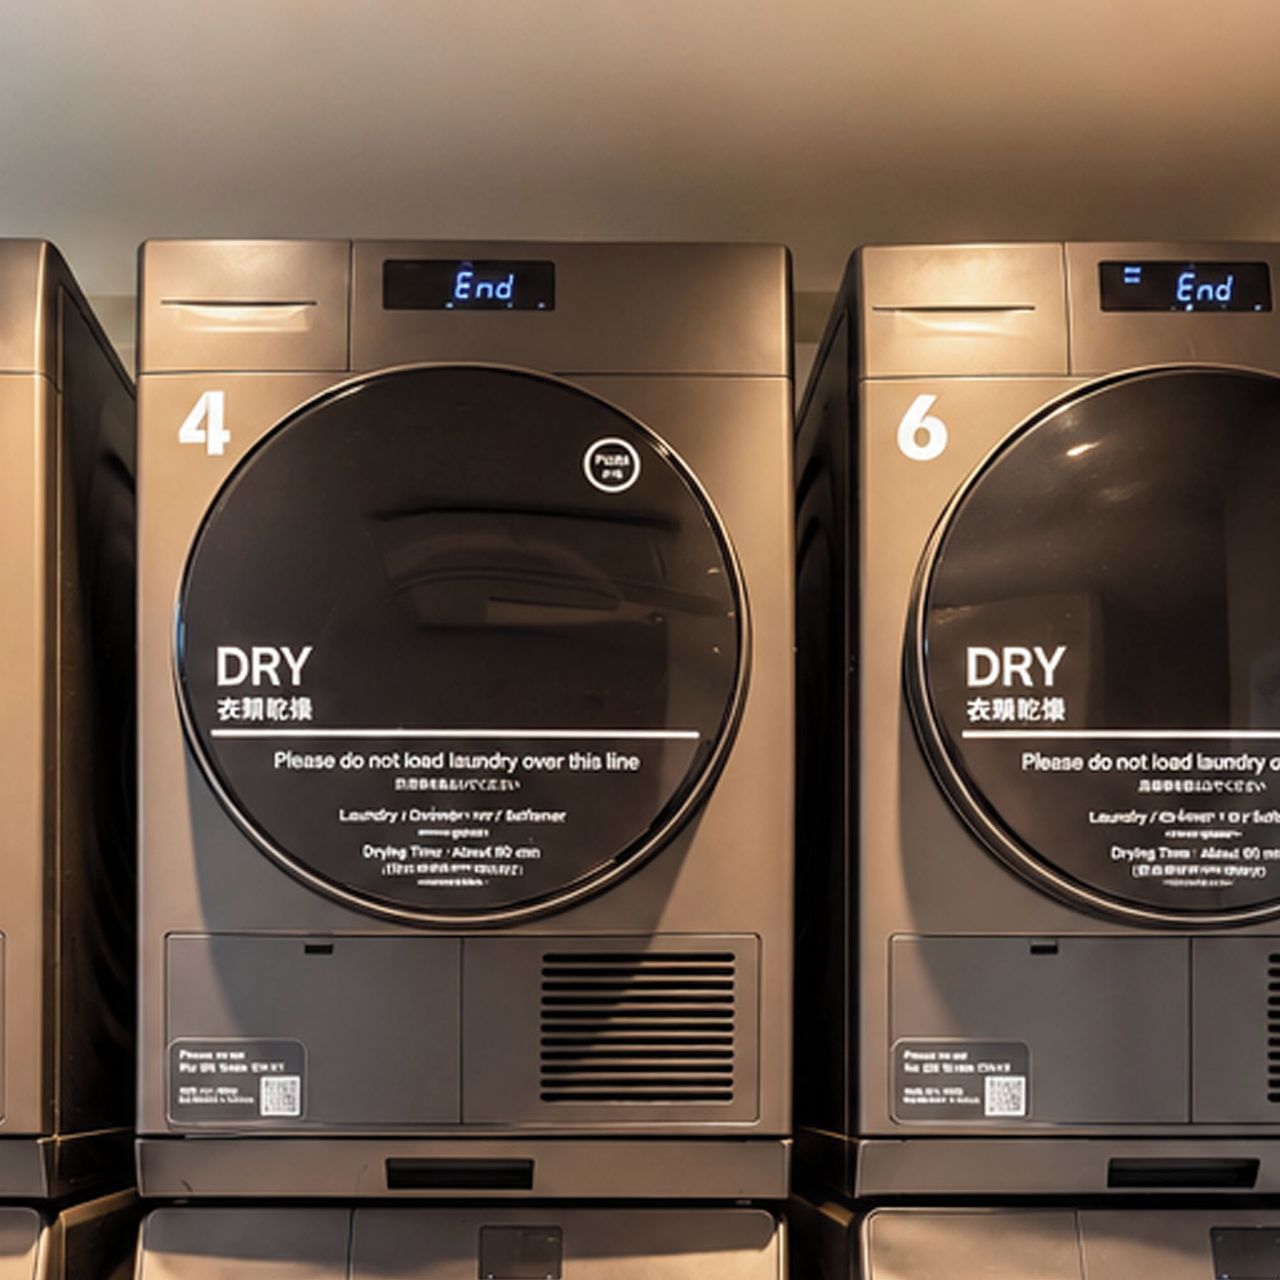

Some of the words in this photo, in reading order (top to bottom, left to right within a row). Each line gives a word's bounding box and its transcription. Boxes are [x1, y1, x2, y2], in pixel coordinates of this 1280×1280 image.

[455, 272, 513, 299] End
[1177, 273, 1232, 301] End
[179, 391, 229, 455] 4
[898, 394, 947, 460] 6
[218, 647, 312, 686] DRY
[968, 646, 1066, 686] DRY
[274, 751, 335, 768] Please
[340, 752, 364, 769] do
[369, 753, 400, 768] not
[405, 752, 444, 768] load
[450, 752, 518, 773] laundry
[522, 756, 565, 769] over
[569, 753, 602, 769] this
[607, 752, 639, 770] line
[1022, 752, 1083, 770] Please
[1088, 753, 1112, 770] do
[1116, 755, 1148, 770] not
[1152, 753, 1192, 770] load
[1197, 753, 1266, 775] laundry
